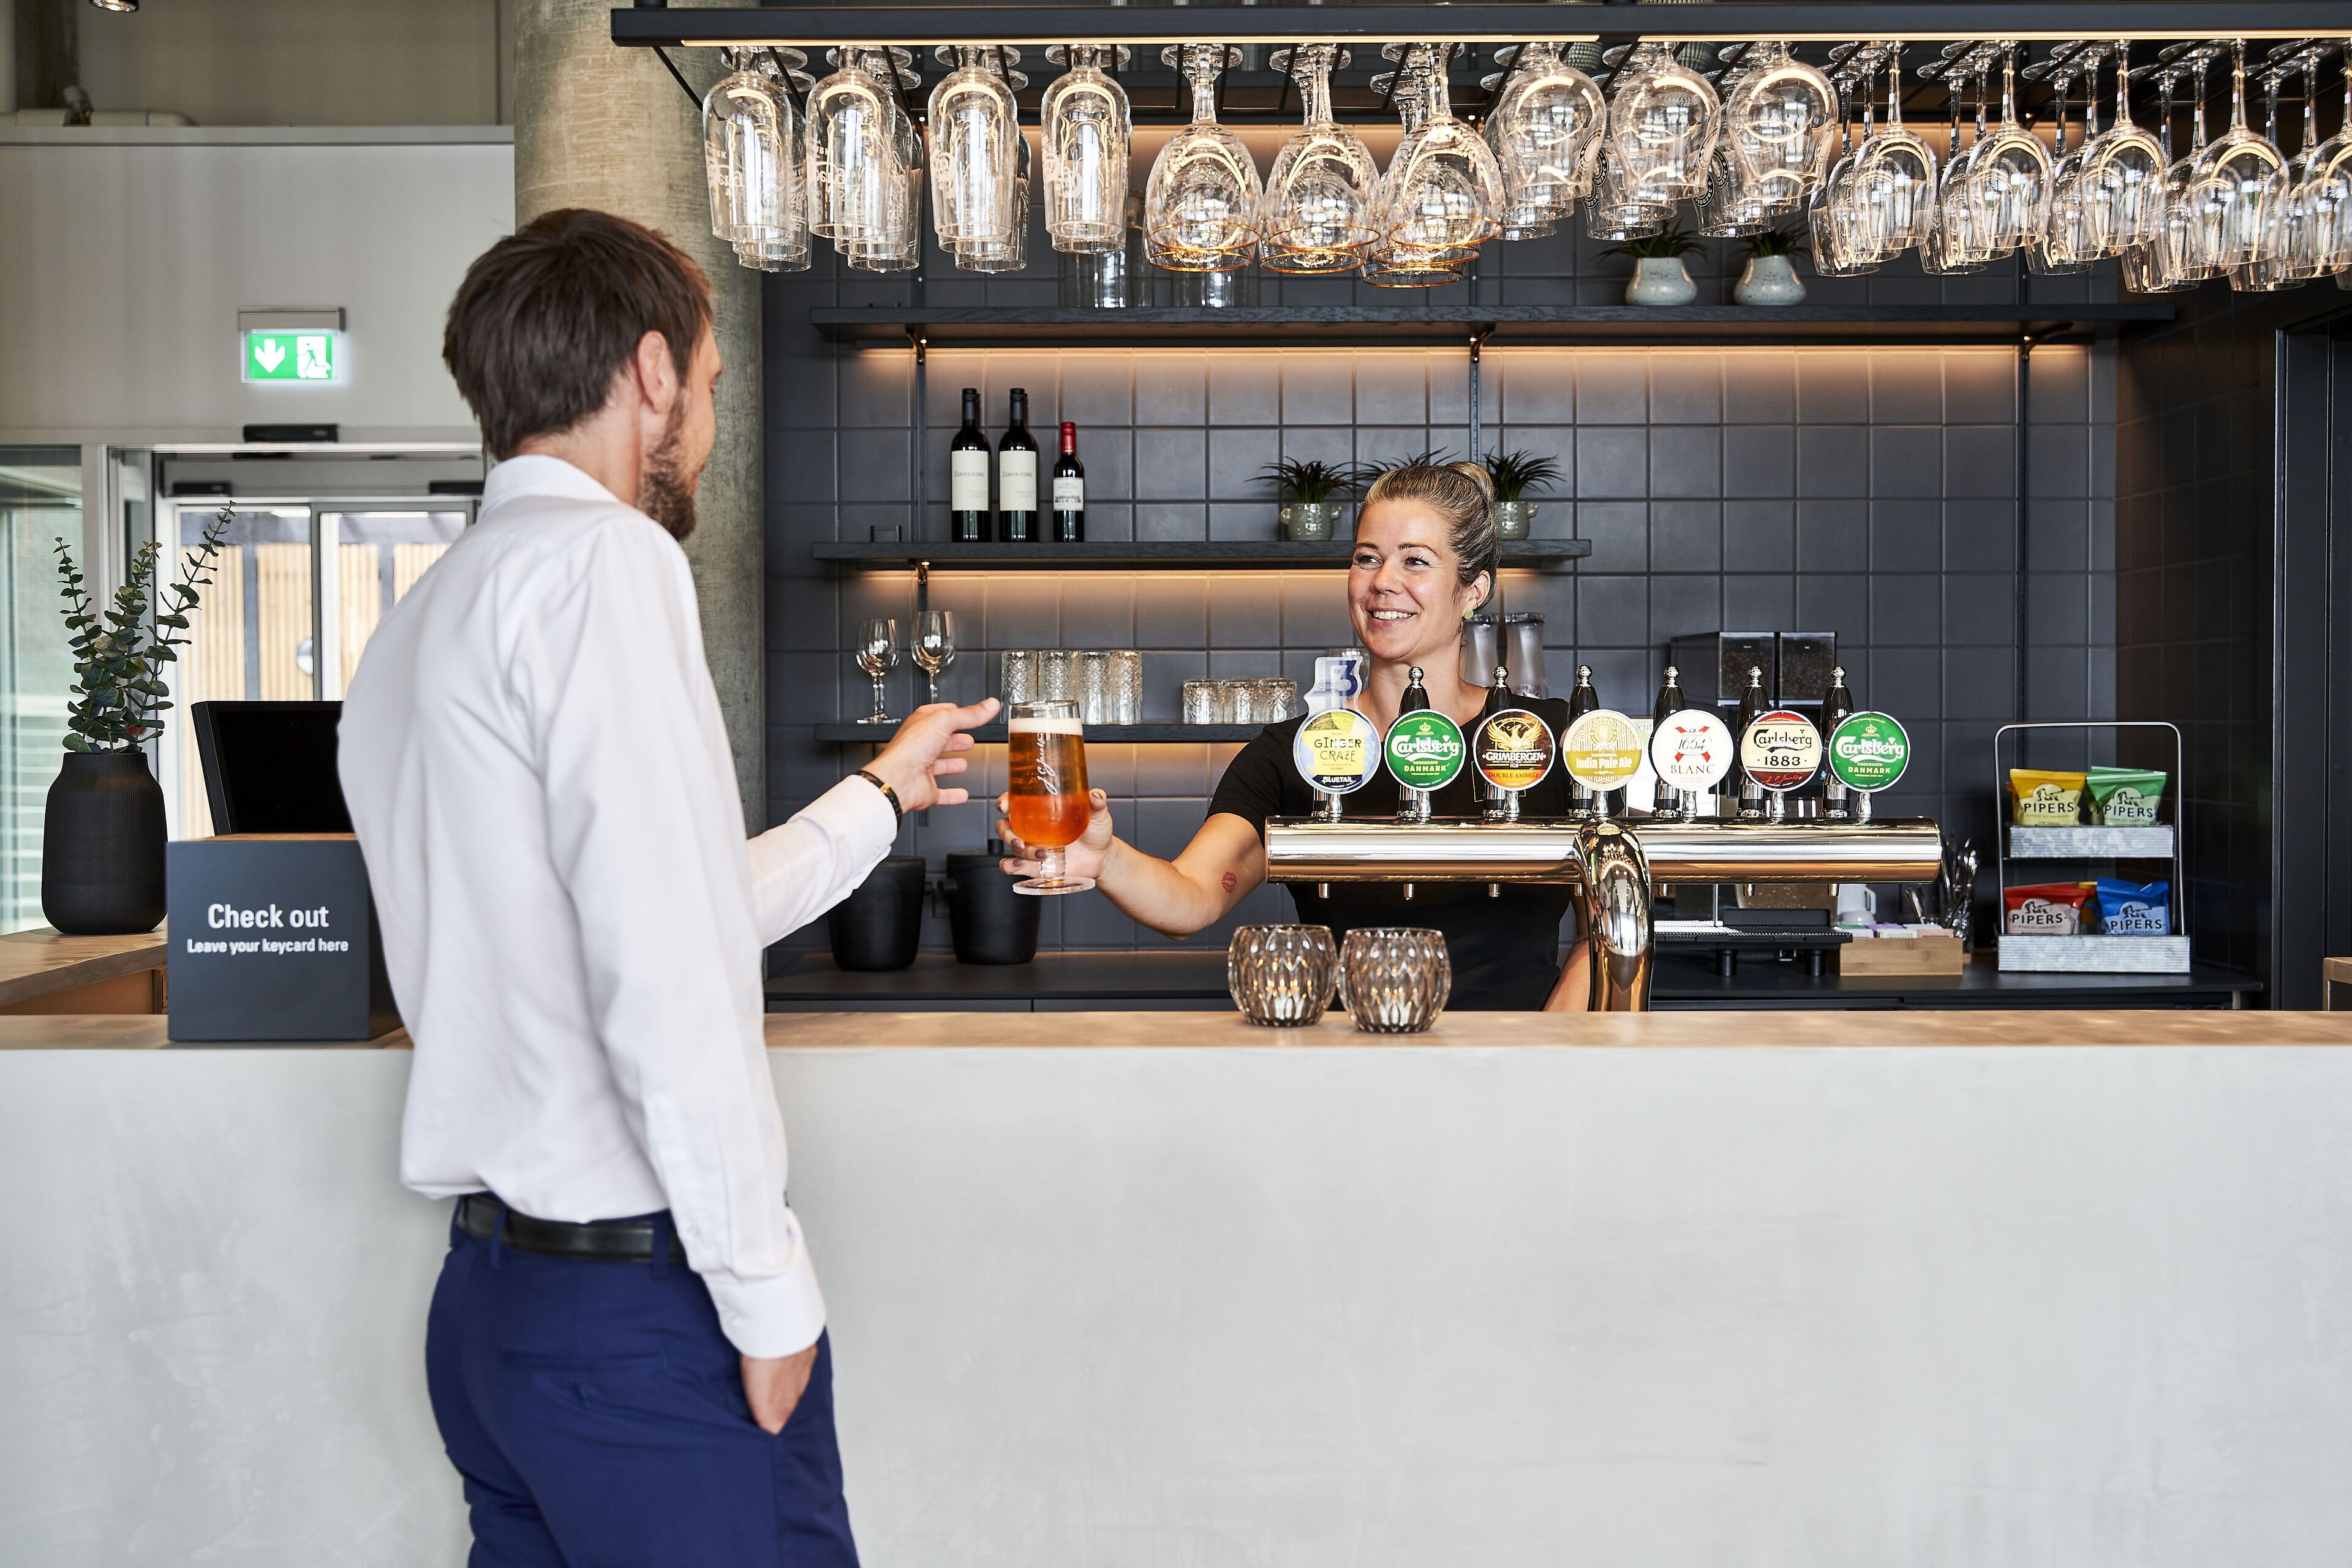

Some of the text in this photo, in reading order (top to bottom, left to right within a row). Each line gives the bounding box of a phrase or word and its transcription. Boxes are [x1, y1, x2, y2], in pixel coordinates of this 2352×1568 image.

[1314, 737, 1362, 748] GINGER
[1678, 737, 1706, 750] 1664
[1754, 729, 1812, 752] Carlsberg
[1391, 735, 1459, 761] Carlsberg
[1836, 736, 1904, 763] Carlsberg
[1320, 750, 1355, 762] CRAZE
[1485, 752, 1544, 761] GRIMBERGEN
[1764, 756, 1801, 766] 1883
[1576, 756, 1632, 769] India Pale Ale
[1671, 764, 1714, 774] BLANC
[2023, 801, 2075, 813] PIPERS
[2104, 804, 2154, 818] PIPERS
[208, 903, 330, 929] Check out
[2011, 913, 2064, 925] PIPERS
[2110, 919, 2162, 931] PIPERS
[187, 938, 349, 956] Leave your keycard here
